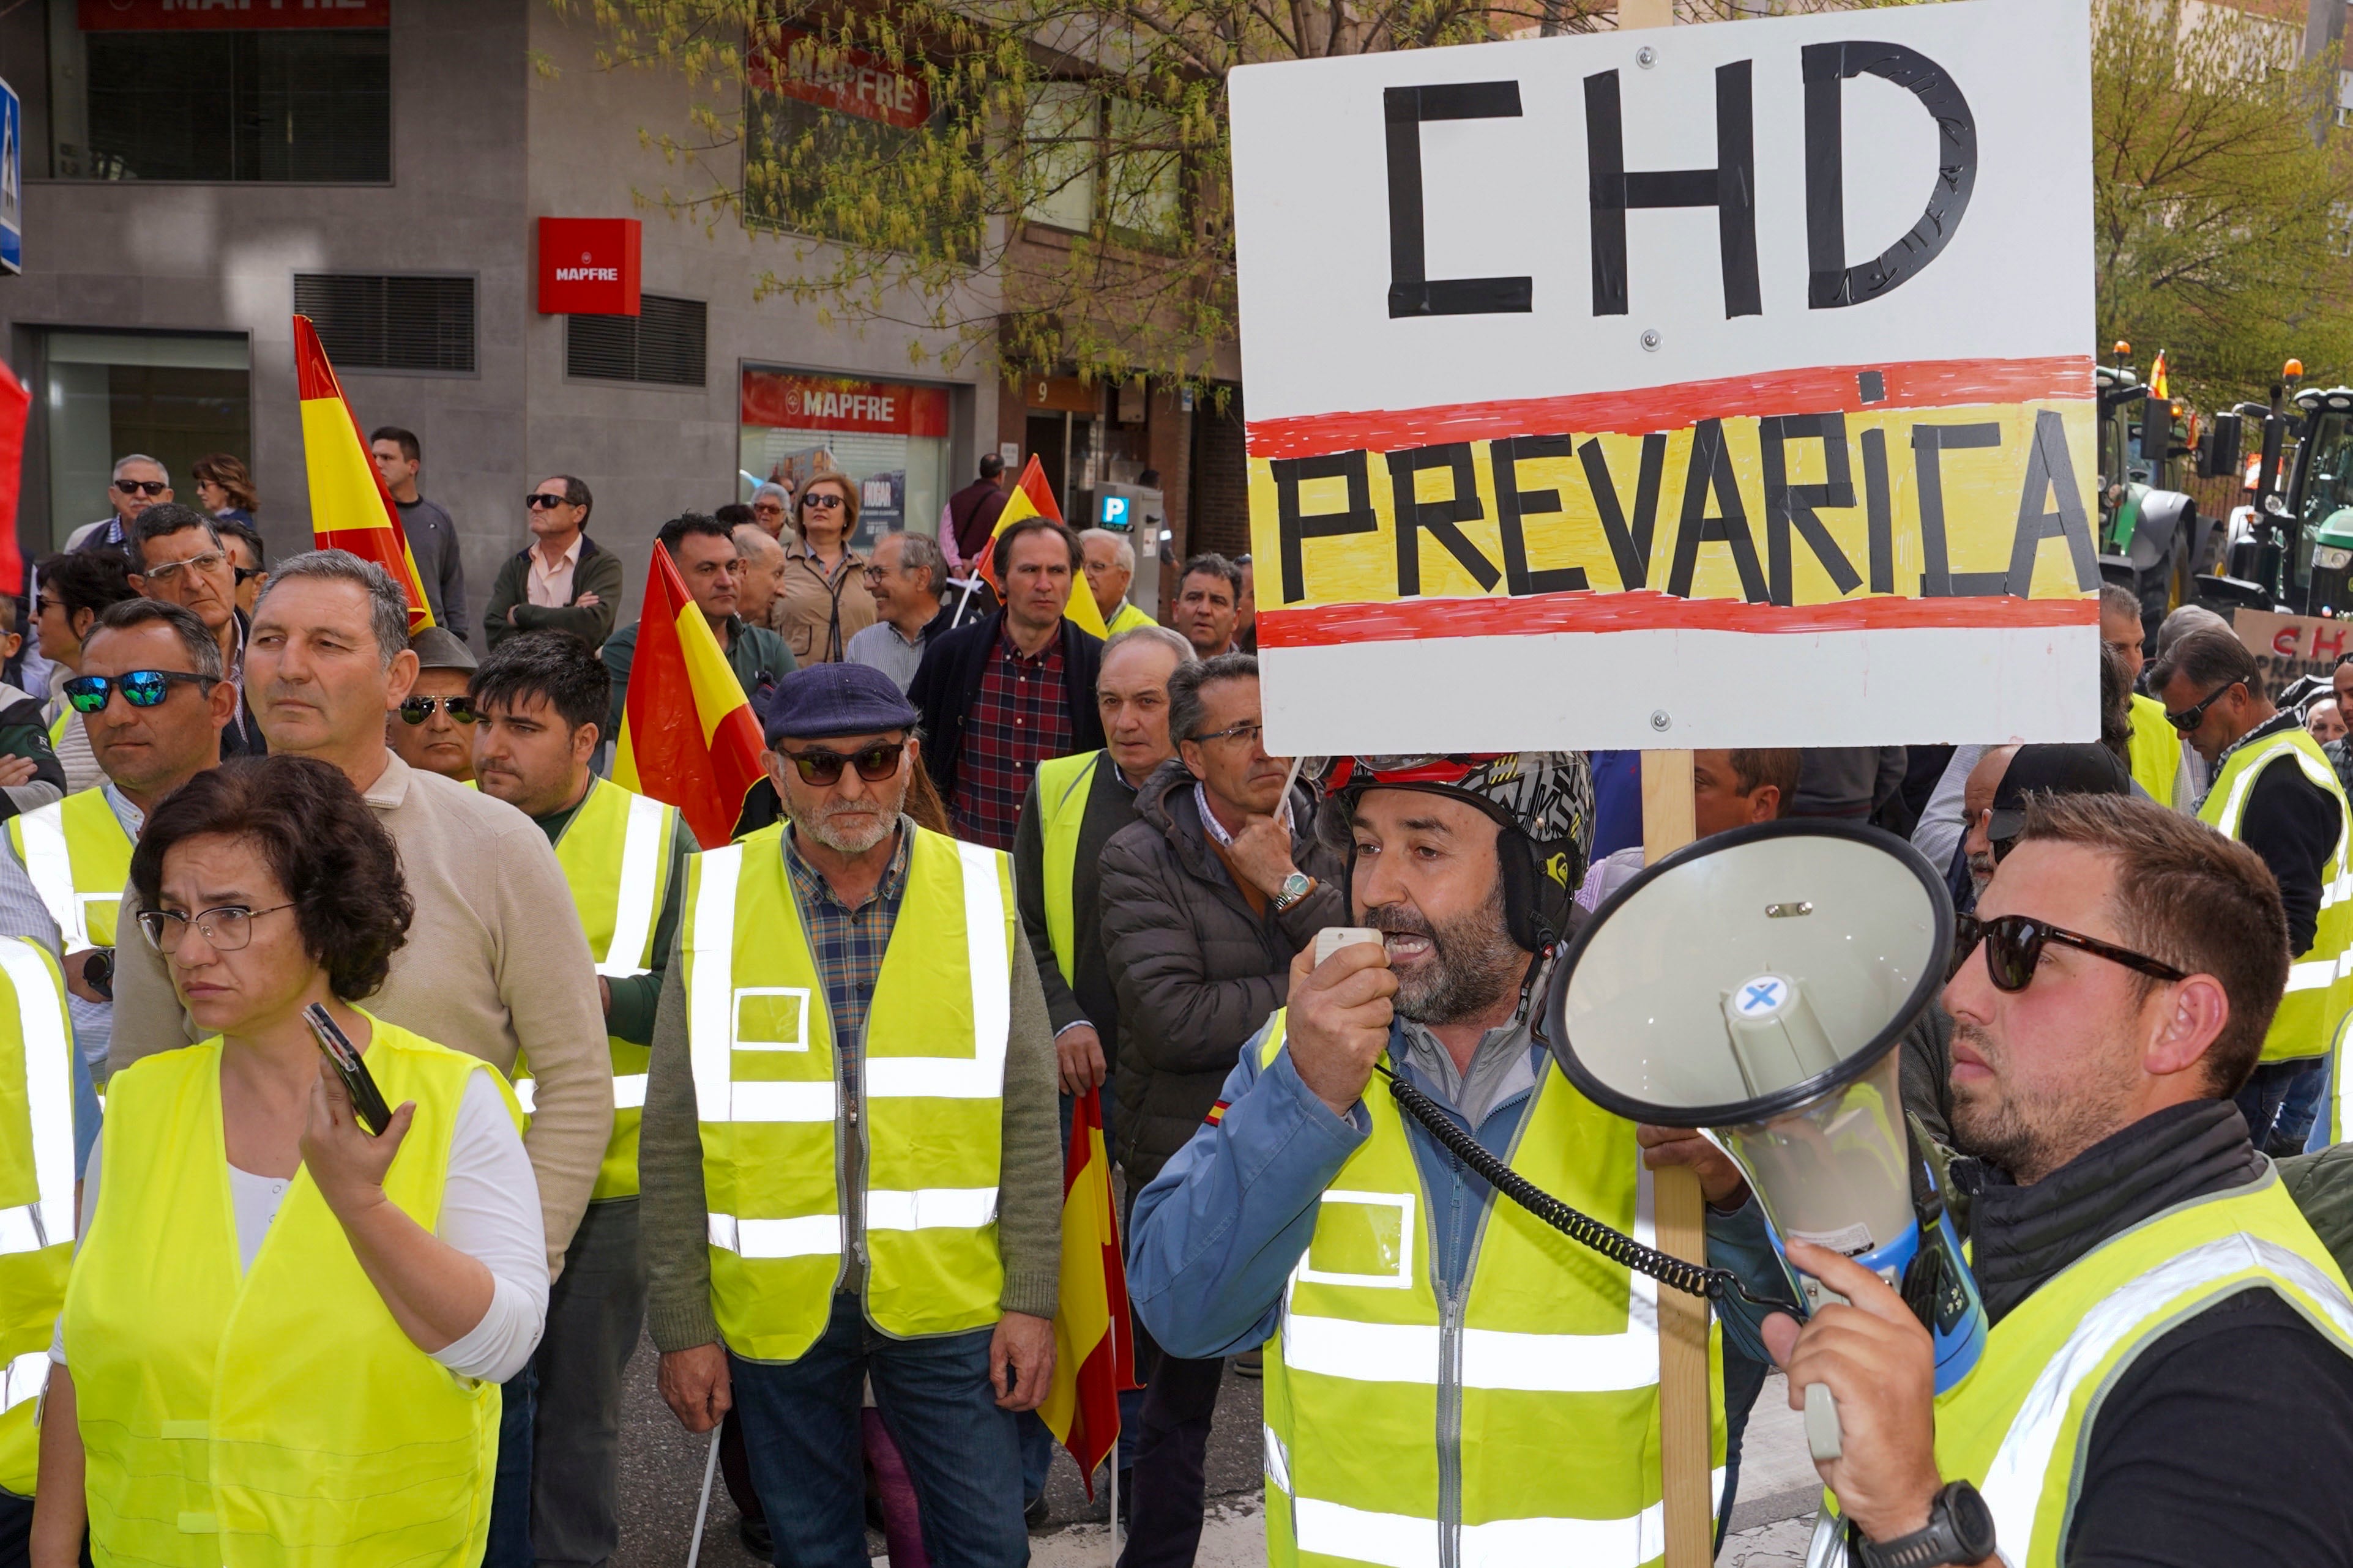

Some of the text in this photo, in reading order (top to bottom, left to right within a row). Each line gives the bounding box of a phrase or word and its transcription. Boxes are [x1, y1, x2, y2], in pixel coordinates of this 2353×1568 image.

[1383, 40, 1978, 319] CHD
[556, 267, 617, 281] MAPFRE
[1039, 382, 1047, 402] 9
[804, 390, 895, 422] MAPFRE
[864, 481, 891, 507] HOGAR
[1106, 497, 1125, 522] P
